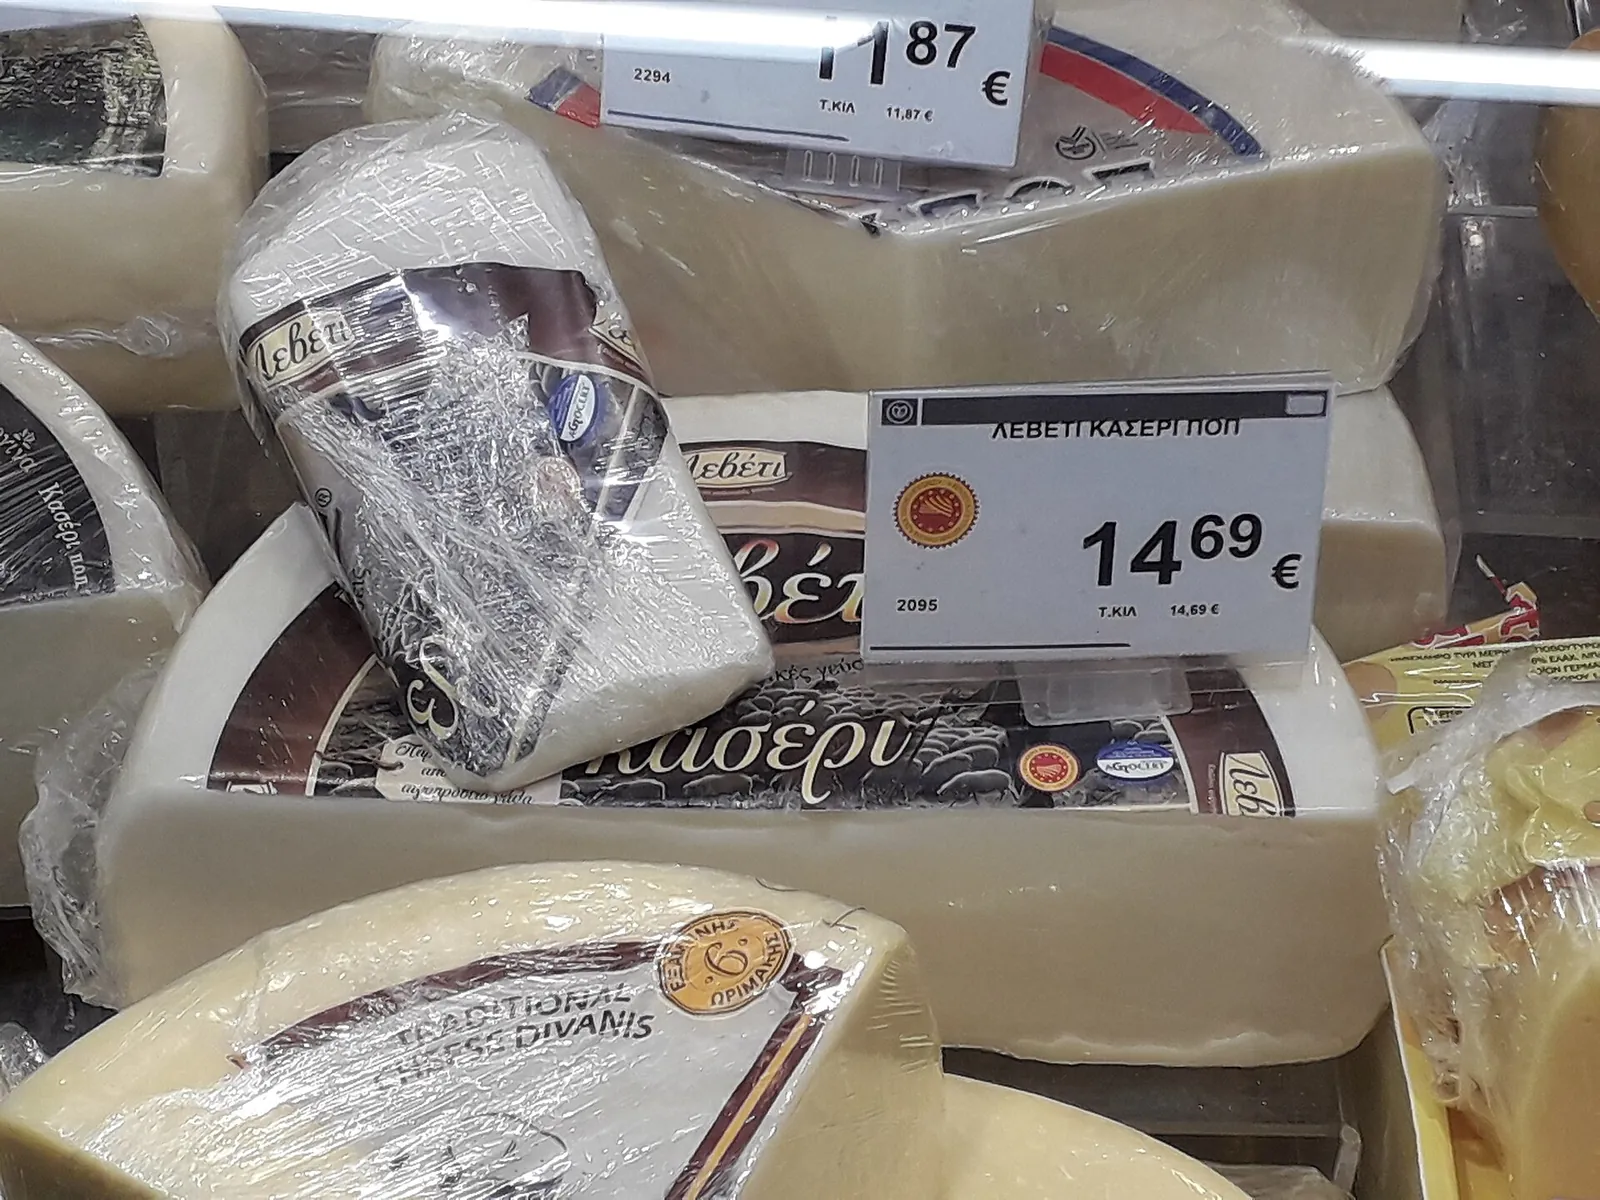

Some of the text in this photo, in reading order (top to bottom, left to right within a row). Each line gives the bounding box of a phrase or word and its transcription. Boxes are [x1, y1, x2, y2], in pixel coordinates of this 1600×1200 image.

[633, 67, 671, 83] 2294
[982, 71, 1010, 105] €
[886, 107, 920, 120] 11,87
[924, 110, 933, 121] €
[991, 417, 1241, 440] ΛΕΒΕΤΙ ΚΑΣΕΡΙ ΠΟΠ
[38, 482, 81, 549] Κασέρι
[1272, 554, 1302, 589] €
[897, 598, 938, 611] 2095
[1210, 604, 1220, 615] €
[515, 1008, 656, 1050] DIVANIS
